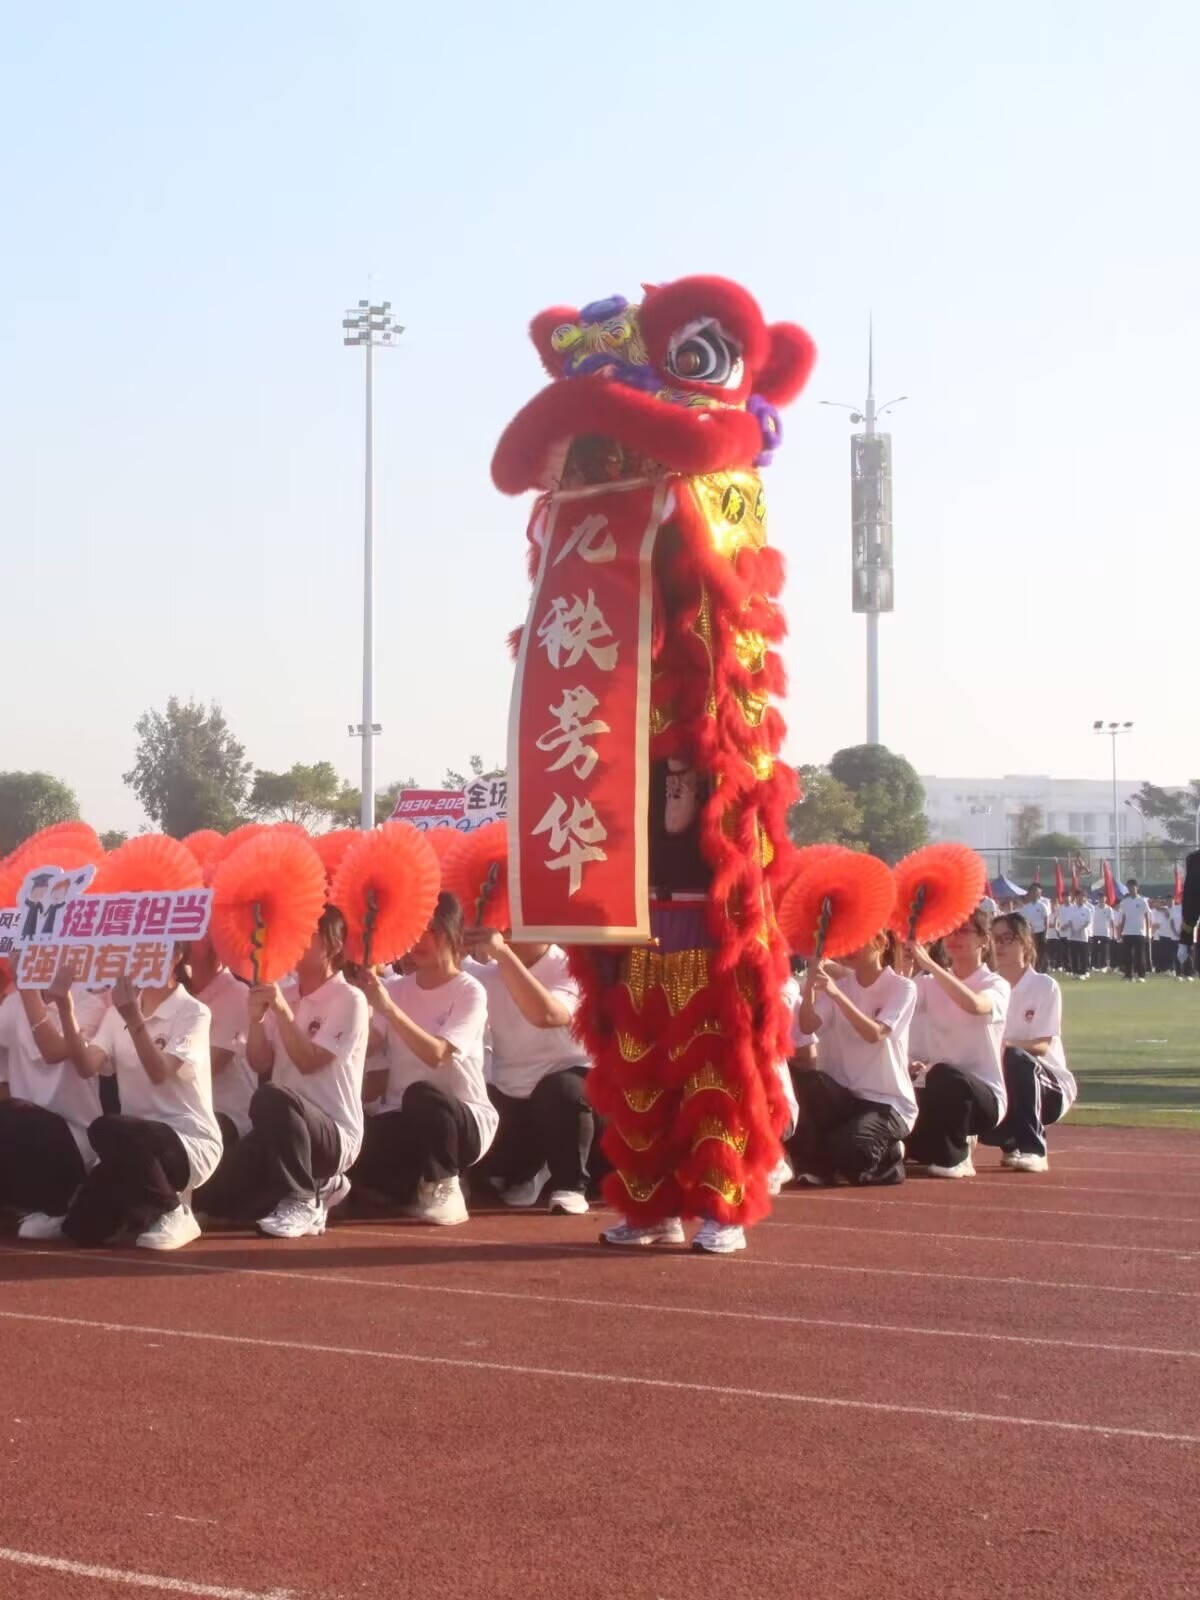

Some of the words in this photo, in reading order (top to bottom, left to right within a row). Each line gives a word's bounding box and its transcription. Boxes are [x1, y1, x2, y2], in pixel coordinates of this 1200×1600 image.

[531, 513, 621, 898] 九秩芳华
[398, 798, 464, 812] 1934-202
[59, 895, 208, 938] 挺膺担当
[21, 941, 168, 983] 强国有我
